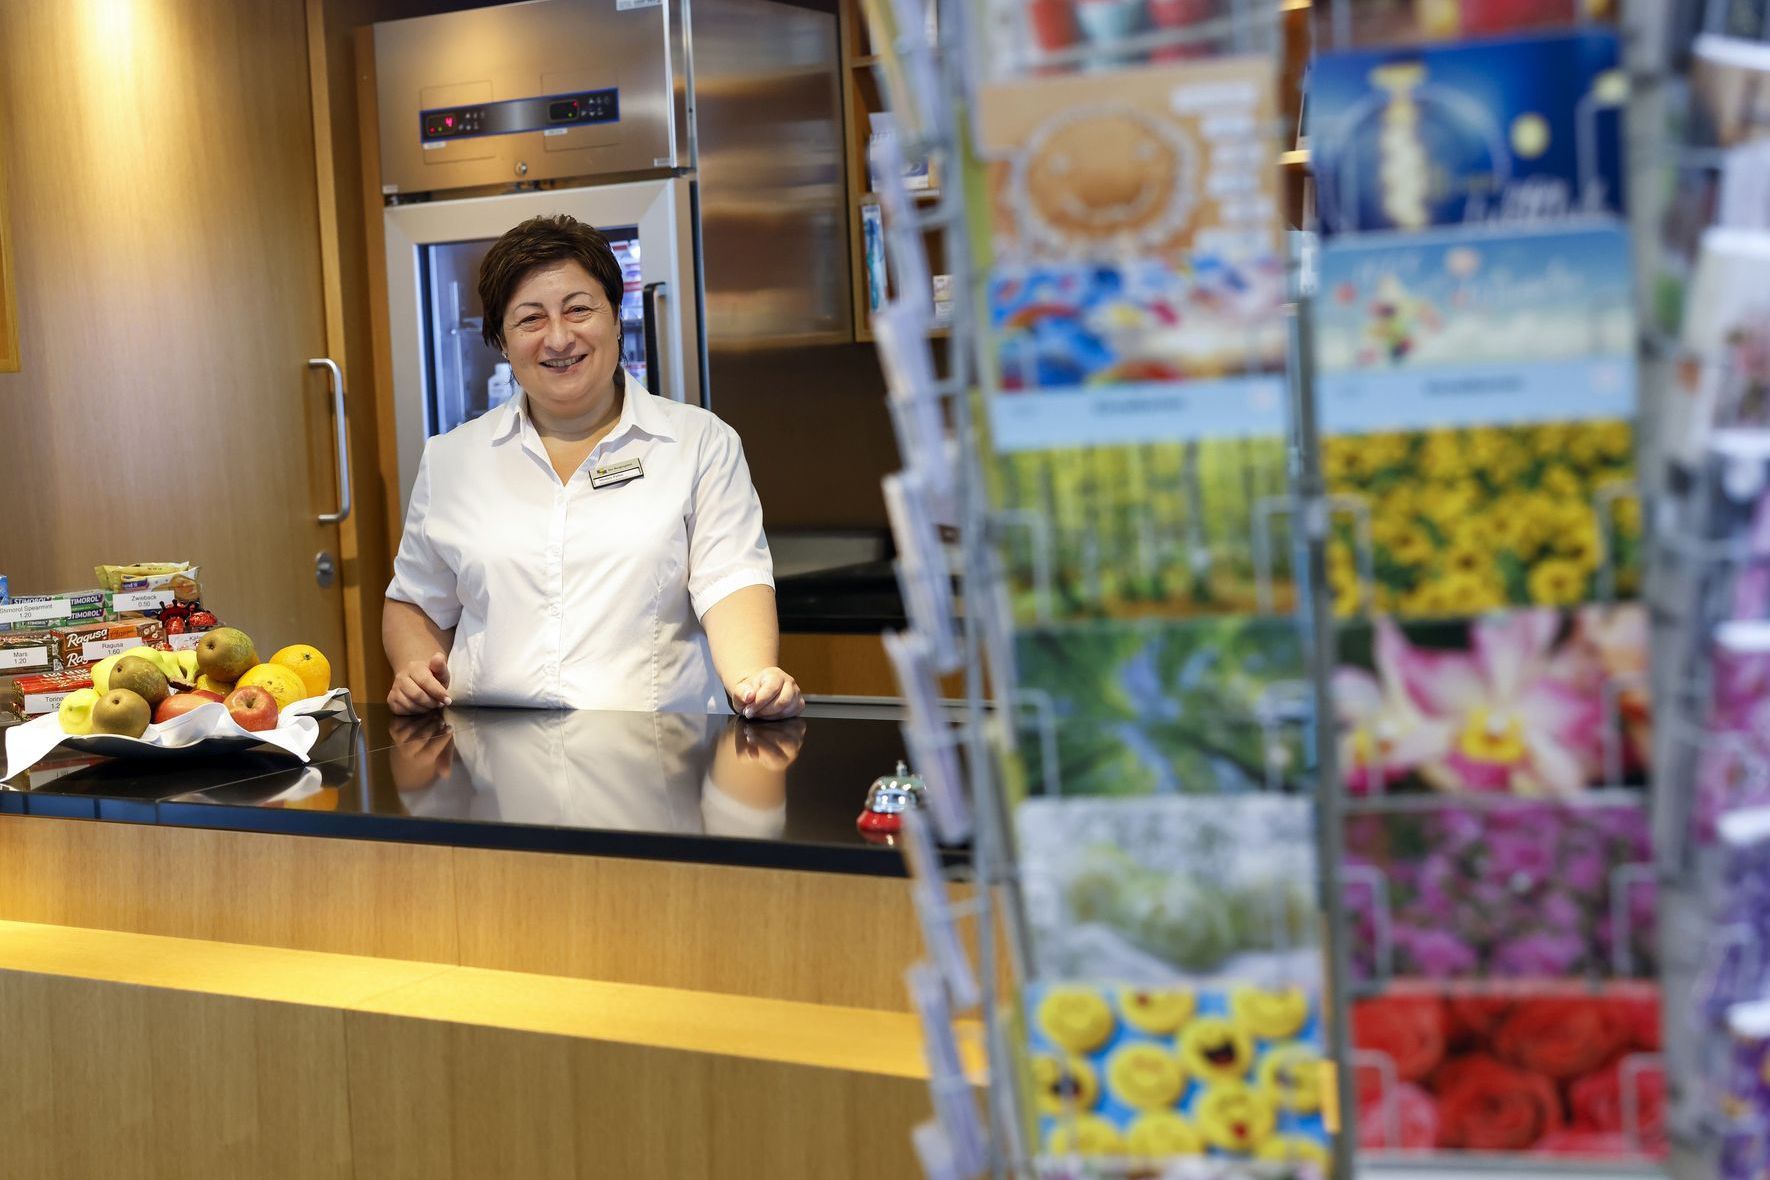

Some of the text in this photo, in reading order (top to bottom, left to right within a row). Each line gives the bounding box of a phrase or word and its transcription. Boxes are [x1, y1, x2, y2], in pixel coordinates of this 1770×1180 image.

[71, 595, 99, 606] TIMOROL
[66, 628, 108, 648] Ragusa
[102, 642, 124, 650] Ragusa
[66, 652, 89, 667] Rag
